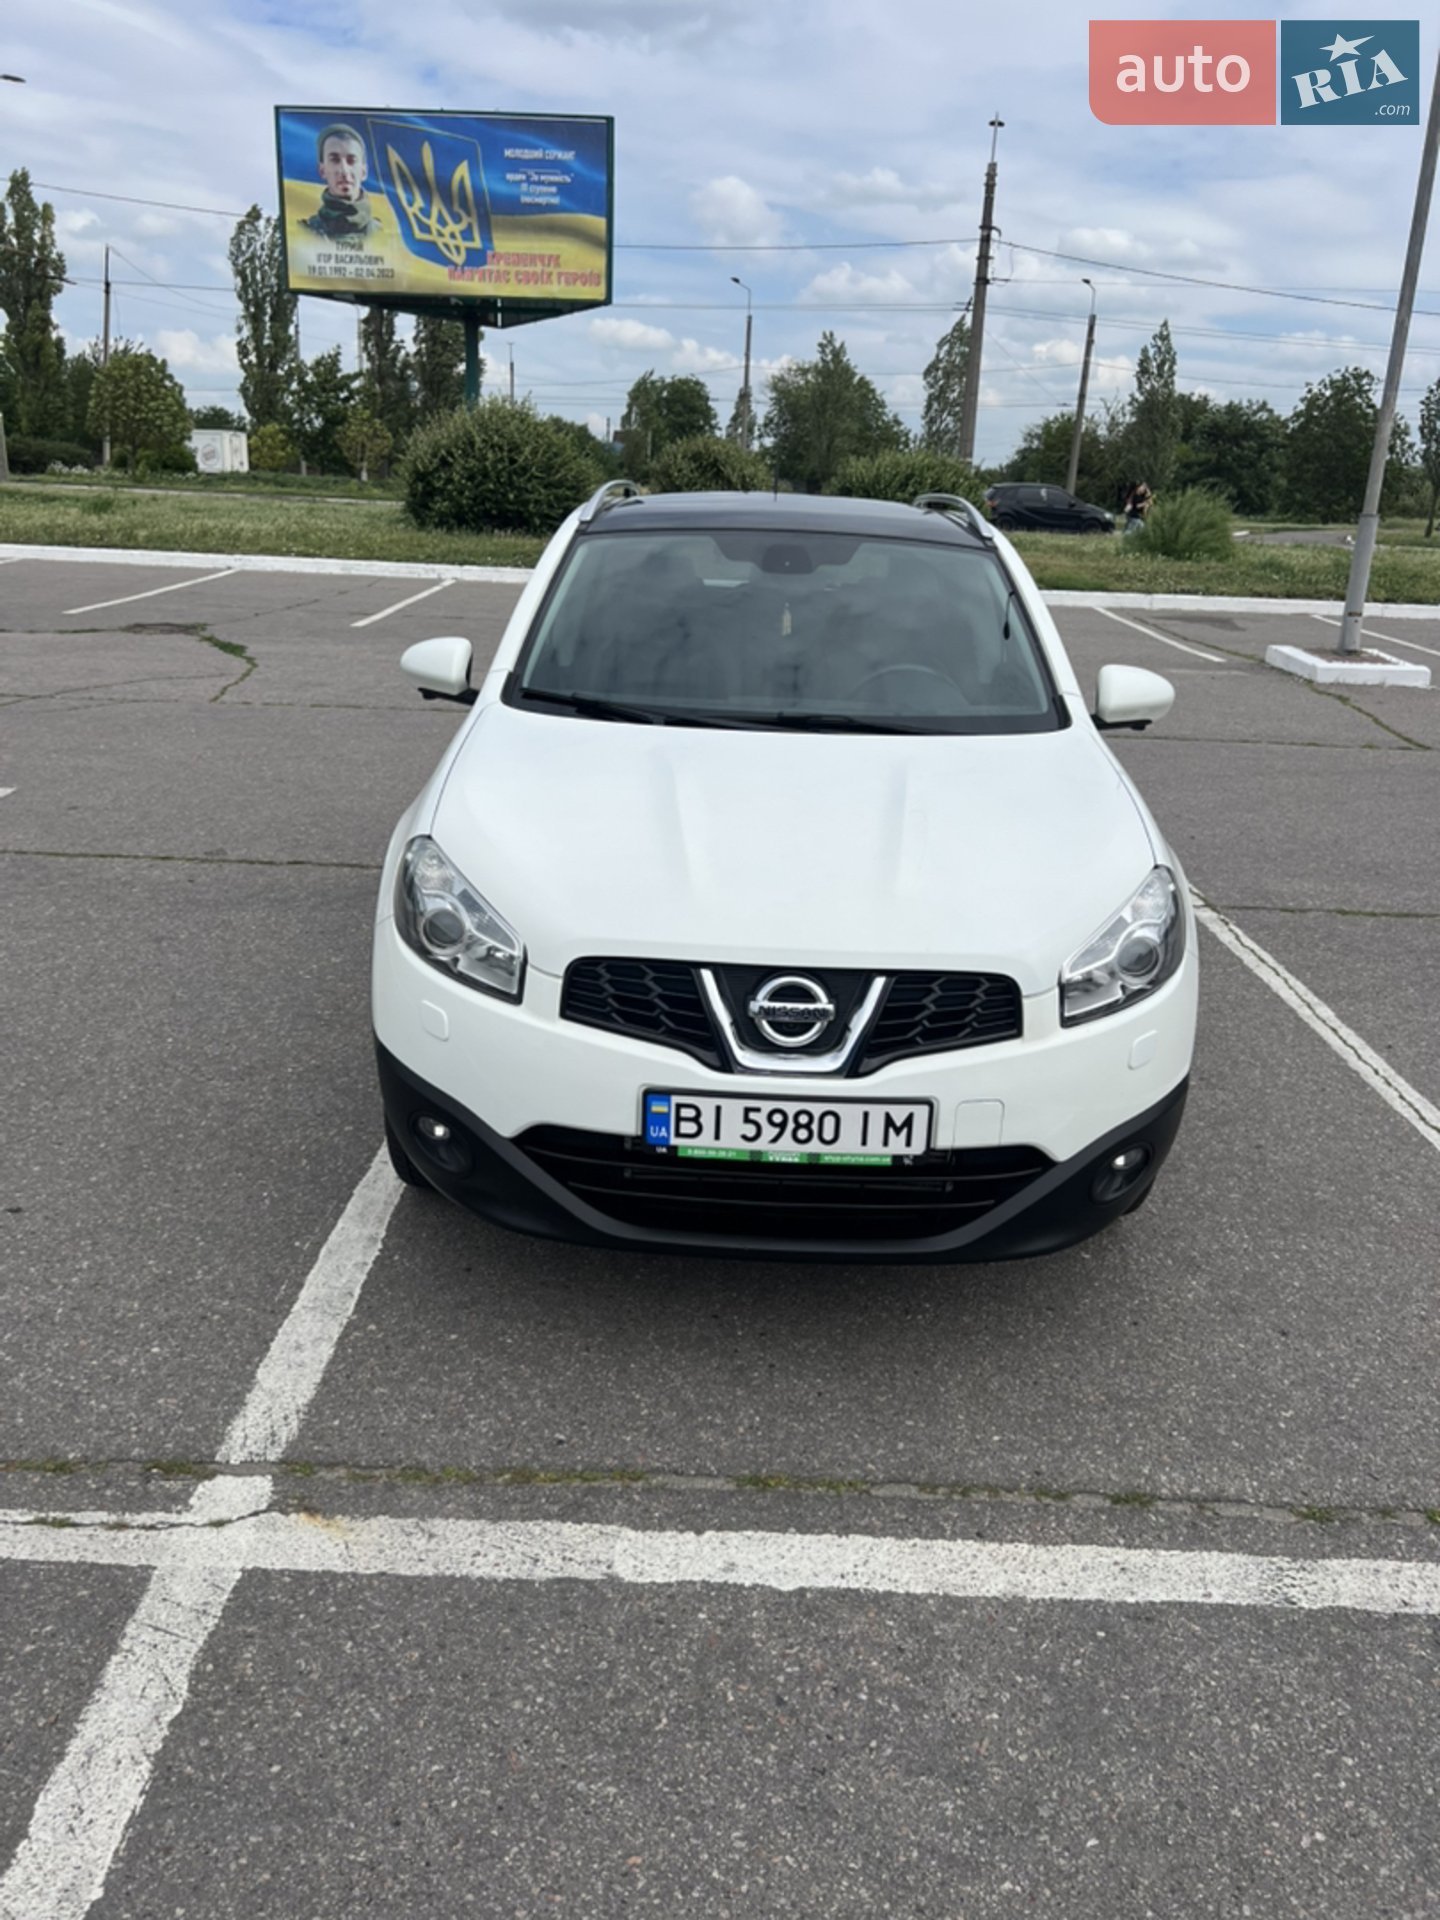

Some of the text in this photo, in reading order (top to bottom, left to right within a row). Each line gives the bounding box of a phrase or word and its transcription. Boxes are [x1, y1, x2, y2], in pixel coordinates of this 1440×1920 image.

[317, 254, 384, 266] ІГОР ВАСИЛЬОВИЧ
[487, 252, 561, 268] КРЕМЕНЧУК
[308, 266, 347, 277] 19.01.1992
[355, 267, 395, 279] 02.04.2023
[514, 269, 553, 285] СВОЇХ
[557, 271, 601, 288] ГЕРОЇВ
[759, 1004, 831, 1020] NISSAN
[650, 1126, 668, 1138] UA
[674, 1102, 914, 1148] BI 5980 IM
